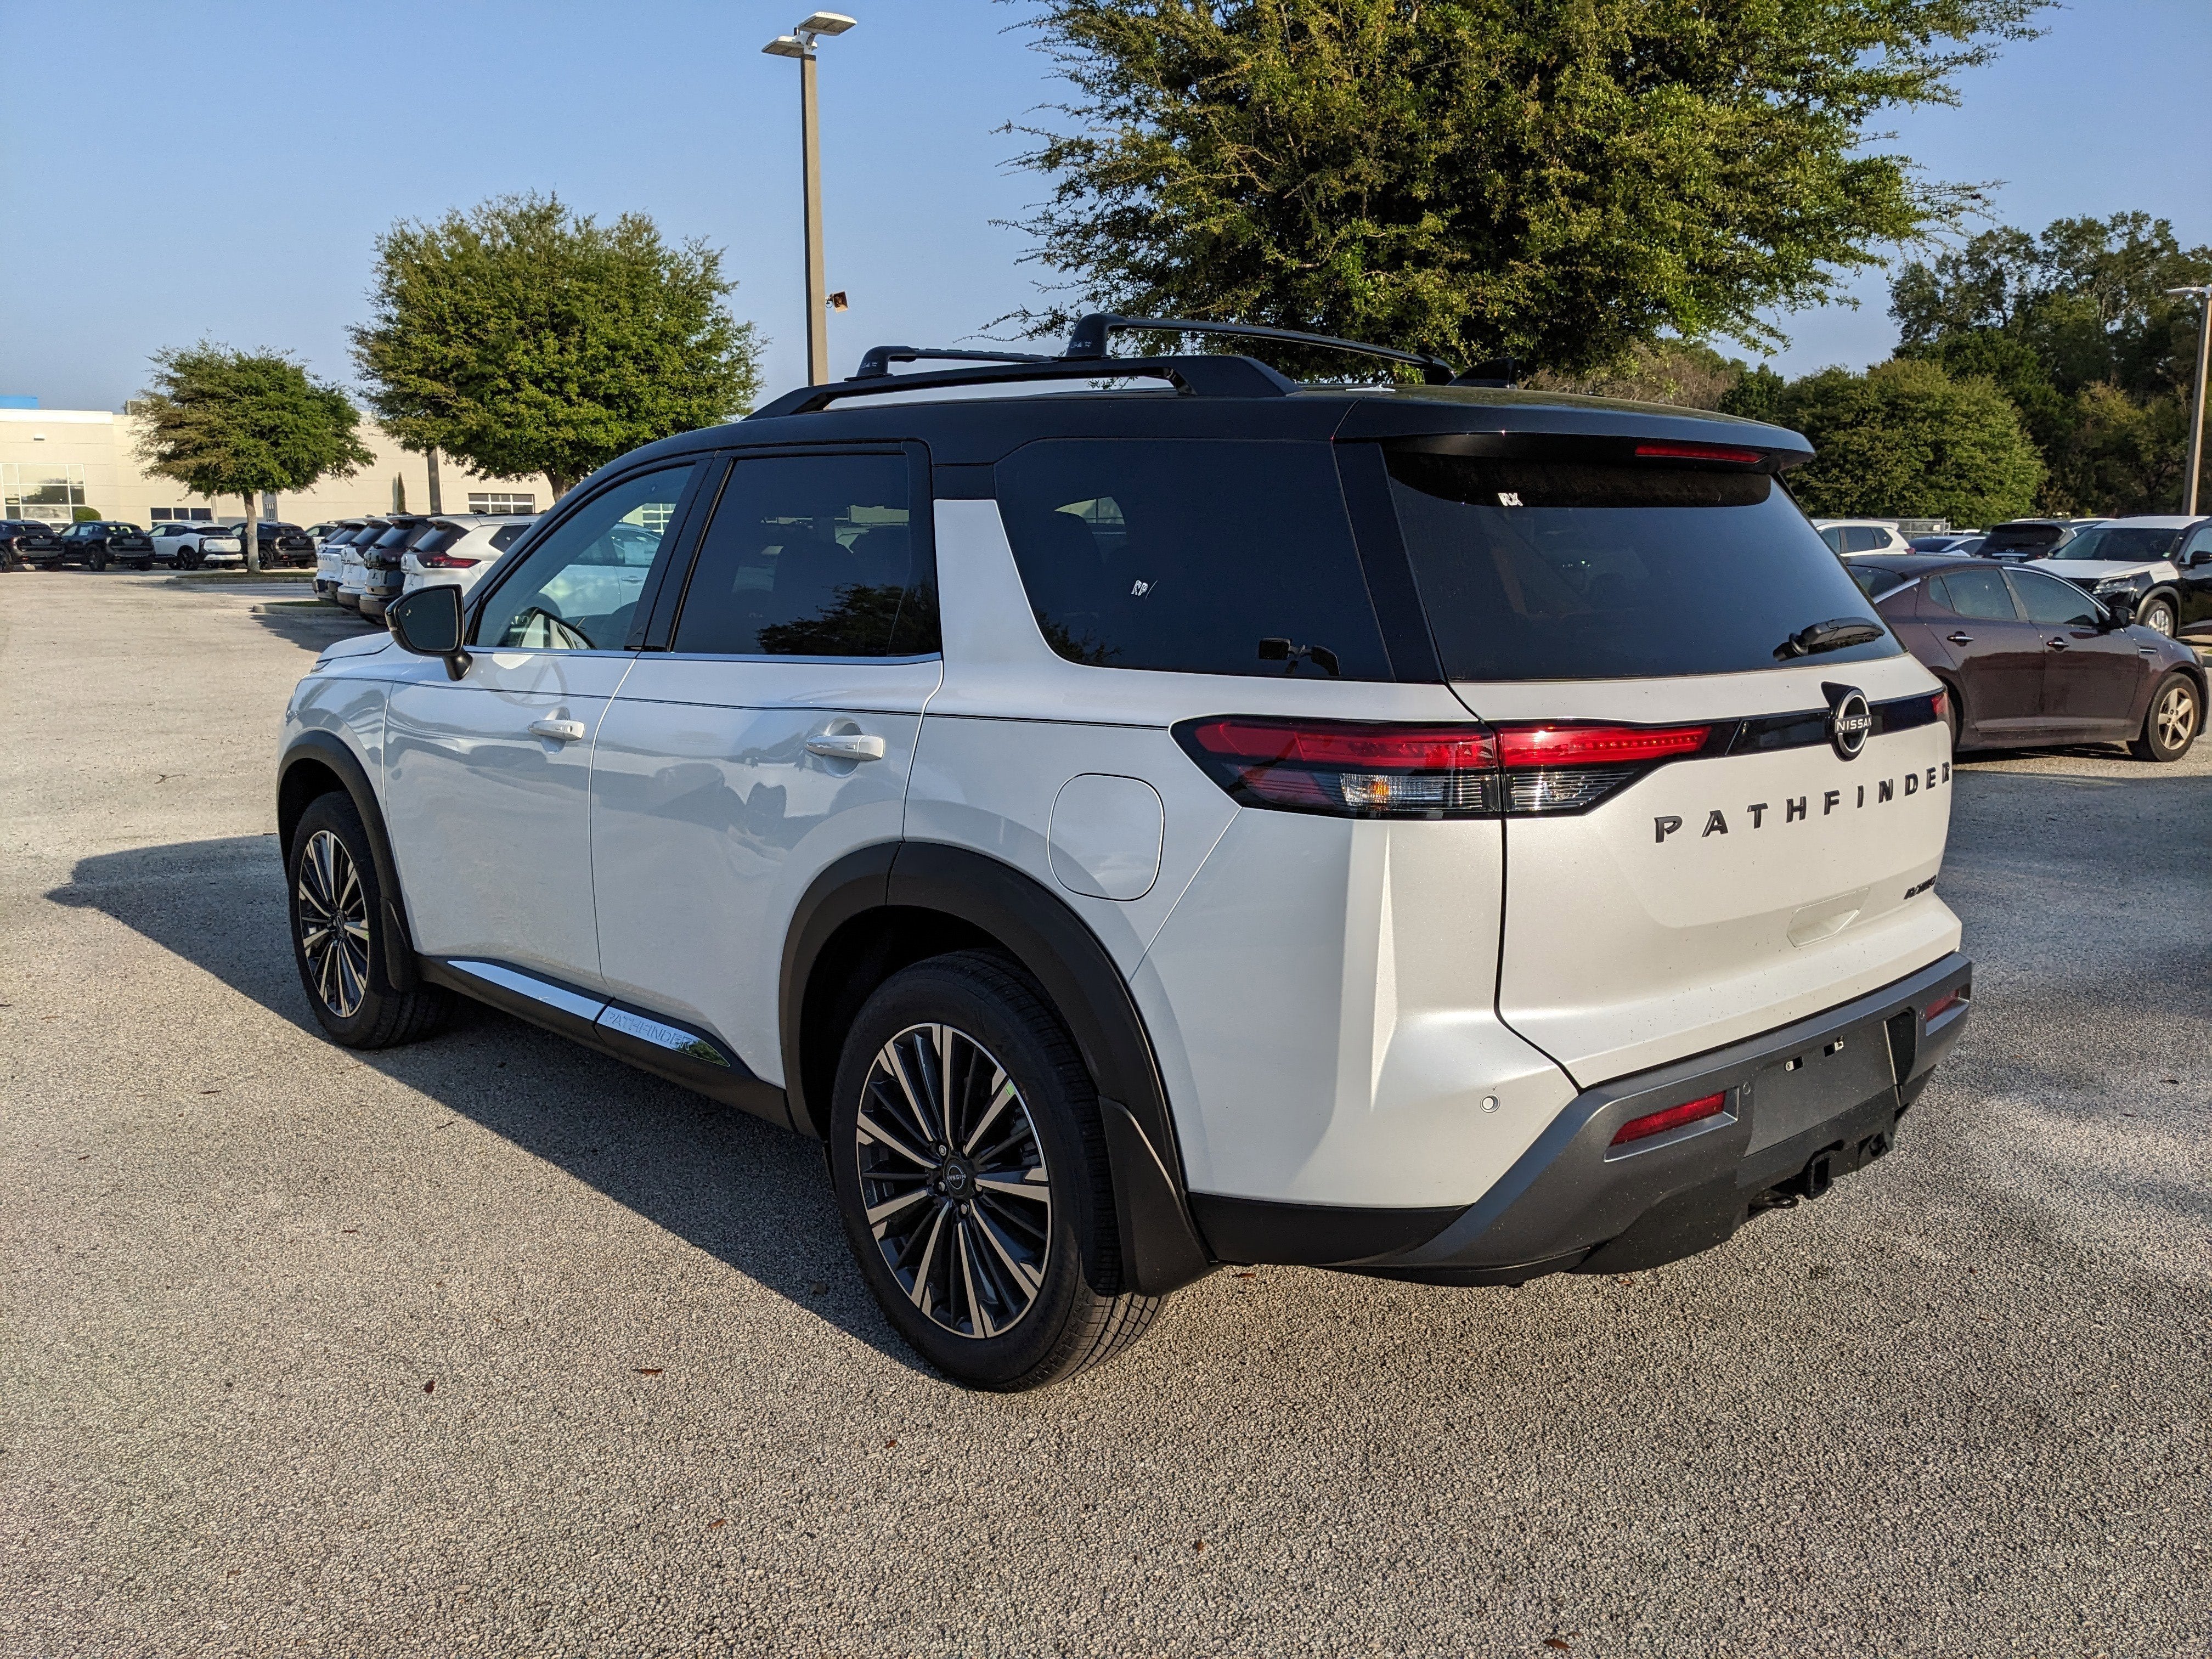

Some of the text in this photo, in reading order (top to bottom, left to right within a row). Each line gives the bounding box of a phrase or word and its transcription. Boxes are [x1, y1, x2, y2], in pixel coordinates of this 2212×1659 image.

[1836, 717, 1872, 731] NISSAN
[1654, 761, 1950, 843] PATHFINDER
[605, 1011, 693, 1051] PATHFINDER
